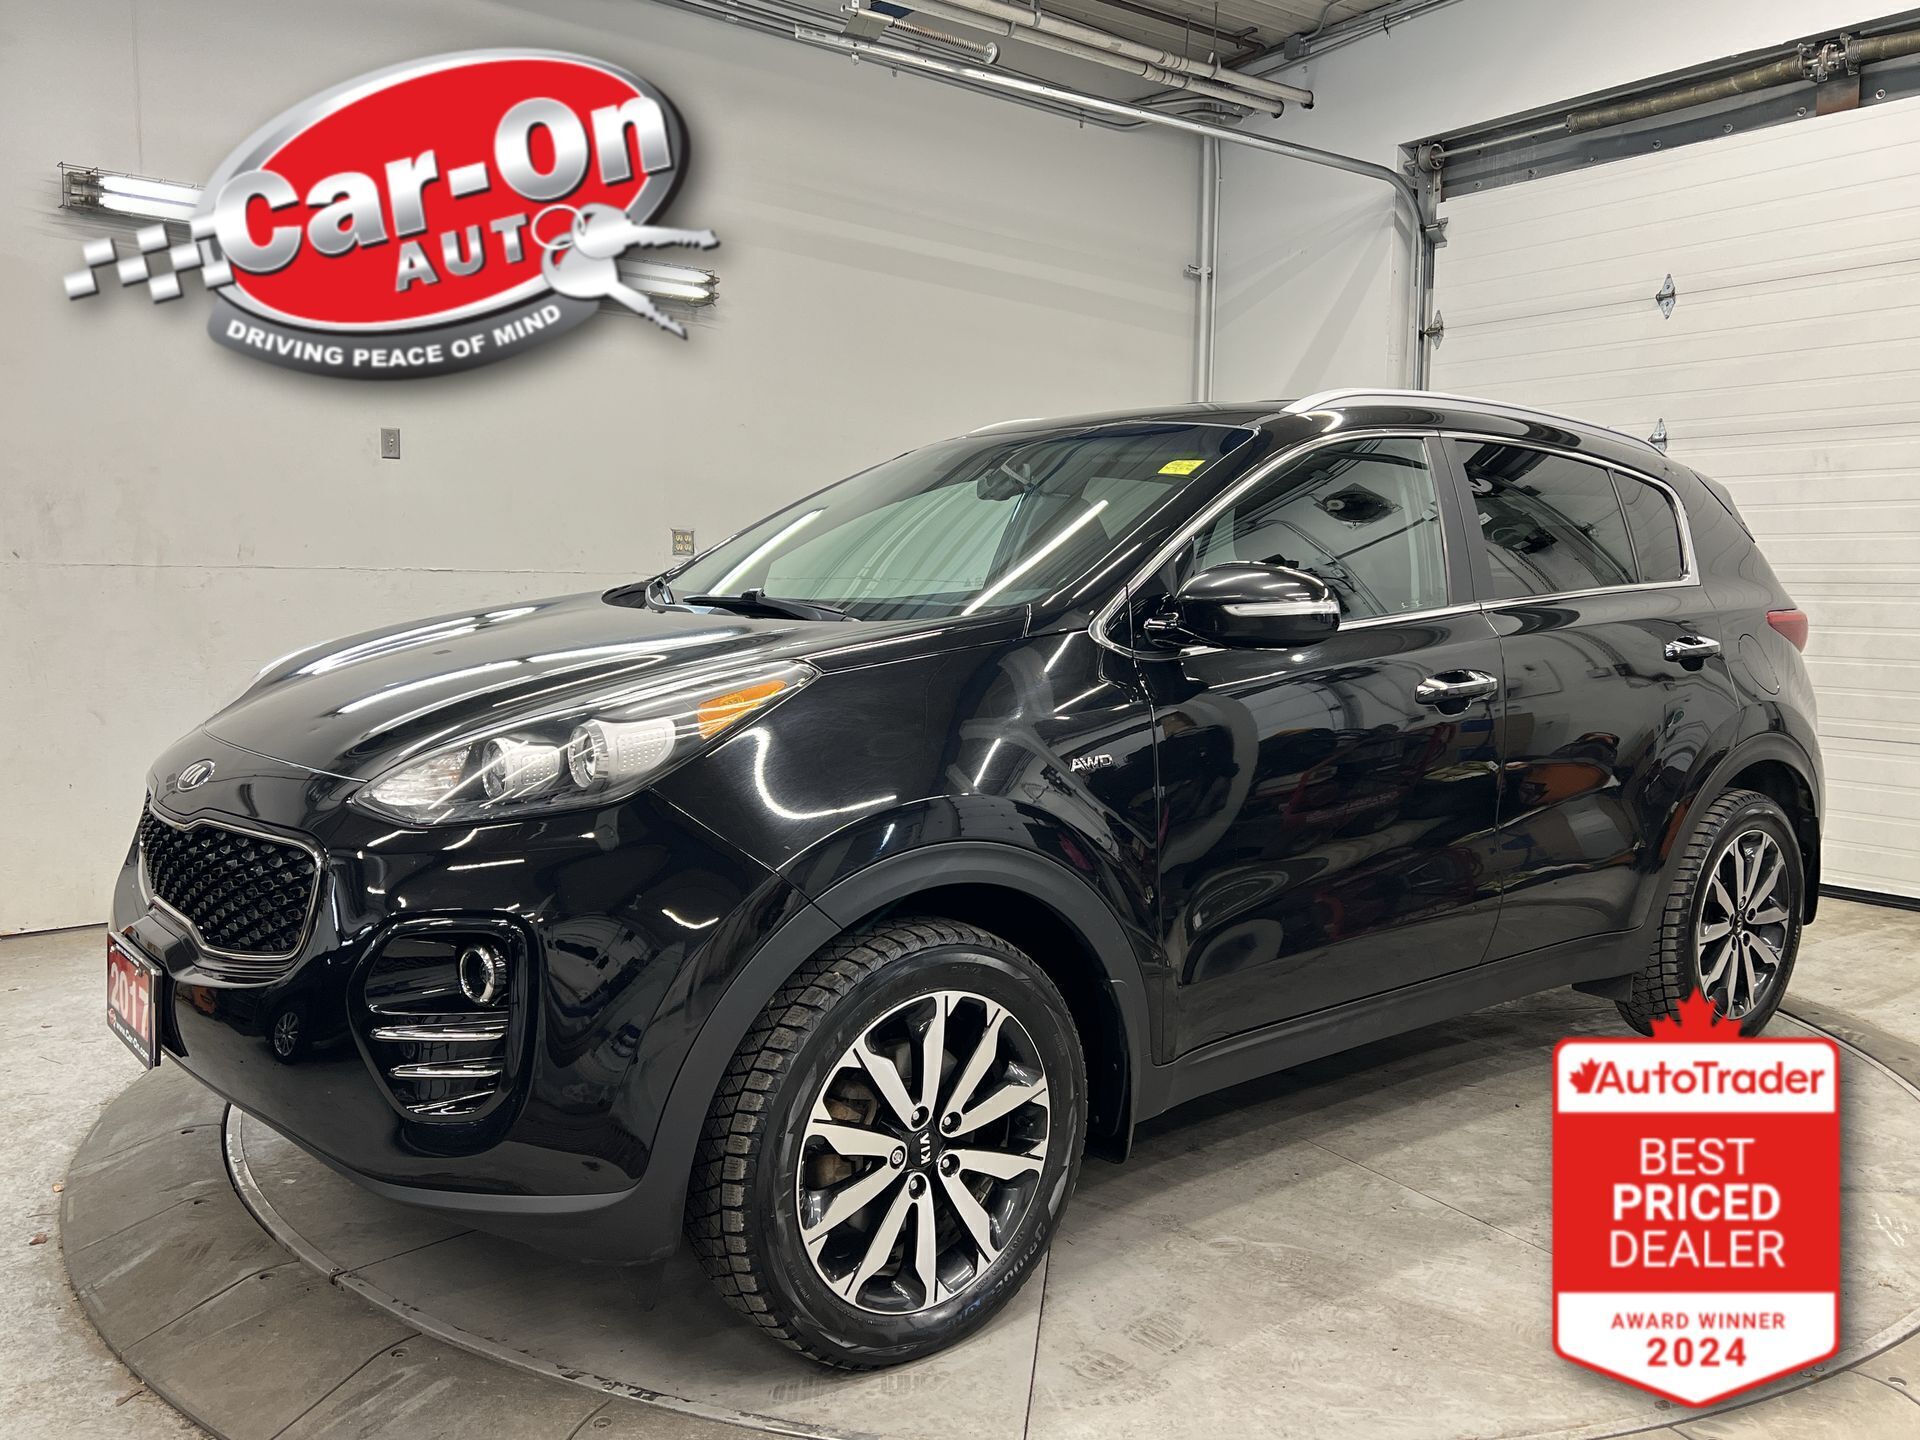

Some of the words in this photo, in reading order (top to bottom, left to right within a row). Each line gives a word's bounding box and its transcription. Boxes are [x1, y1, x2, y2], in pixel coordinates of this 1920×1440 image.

[1070, 753, 1113, 772] AWD
[110, 961, 149, 1042] 2017
[920, 1132, 931, 1165] KIA
